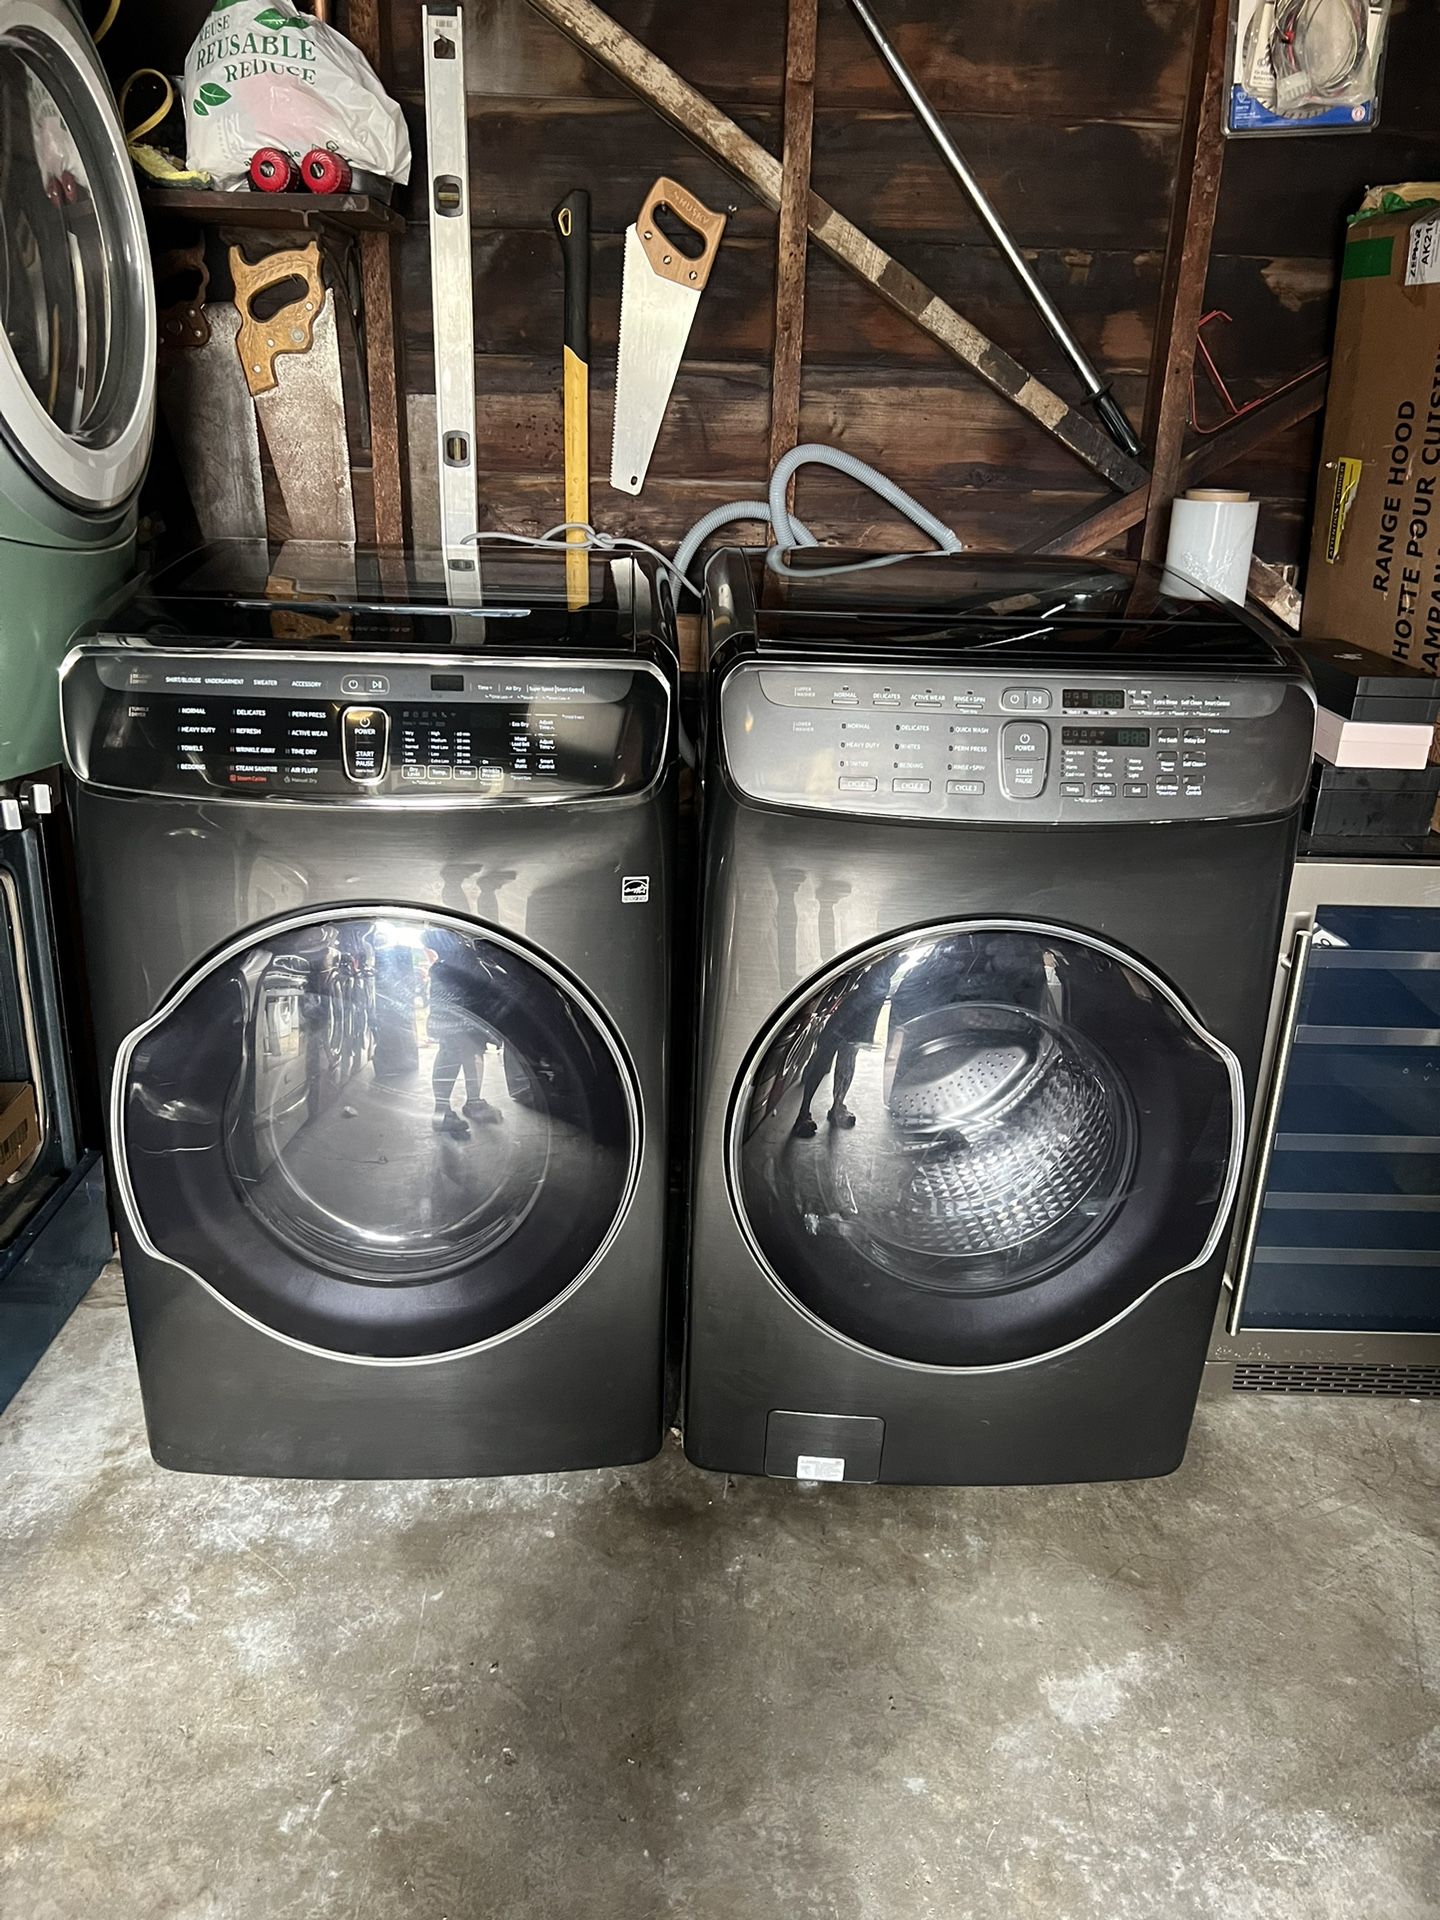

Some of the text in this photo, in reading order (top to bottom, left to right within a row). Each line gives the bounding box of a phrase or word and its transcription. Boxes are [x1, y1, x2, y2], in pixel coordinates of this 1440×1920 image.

[199, 14, 231, 43] REUSE
[196, 33, 317, 72] REUSABLE
[224, 59, 316, 86] REDUCE
[679, 198, 710, 224] HUSKY
[1373, 401, 1415, 592] RANGE HOOD
[1392, 567, 1420, 660] HOTTE
[1406, 476, 1437, 558] POUR
[253, 679, 278, 687] SWEATER
[833, 691, 857, 699] NORMAL
[236, 709, 267, 717] DELICATES
[955, 726, 973, 734] QUICK
[1014, 744, 1036, 752] POWER
[181, 763, 206, 771] BEDDING
[1014, 776, 1033, 784] PAUSE
